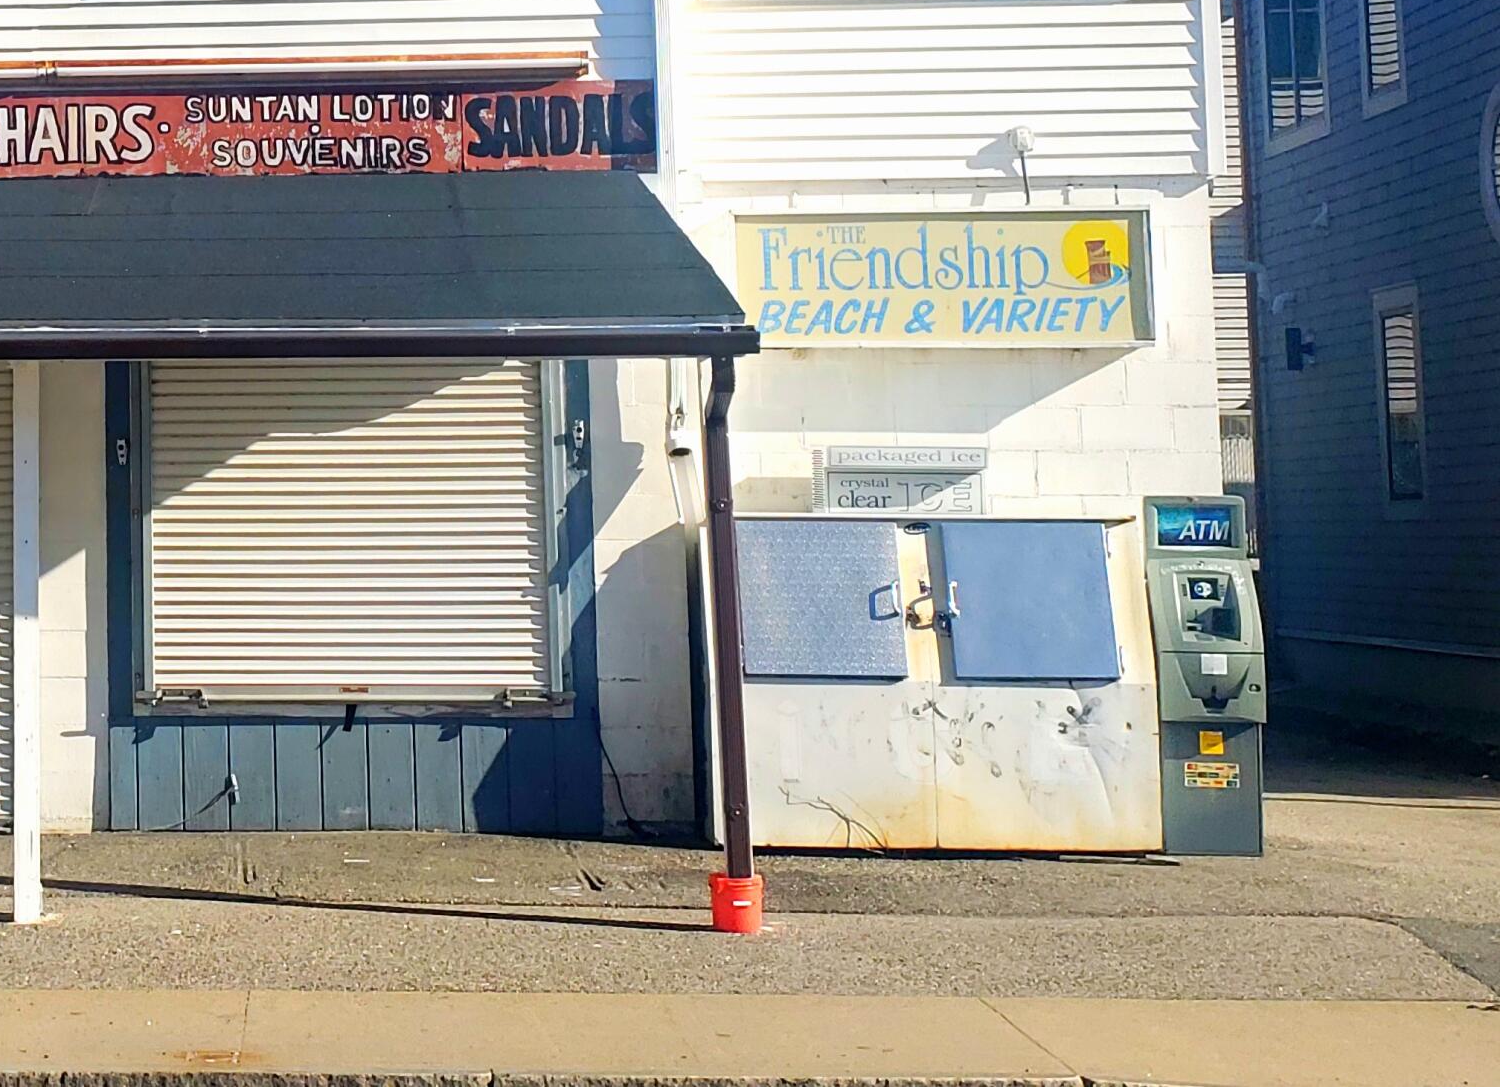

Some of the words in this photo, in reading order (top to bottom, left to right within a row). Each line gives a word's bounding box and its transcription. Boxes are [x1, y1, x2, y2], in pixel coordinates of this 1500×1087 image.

[184, 94, 321, 123] SUNTAN
[330, 94, 456, 122] LOTION
[465, 92, 658, 158] SANDALS
[211, 135, 432, 169] SOUVENIRS
[826, 225, 867, 245] THE
[756, 221, 1050, 296] Friendship
[758, 297, 889, 336] BEACH
[904, 299, 937, 334] &
[960, 295, 1126, 335] VARIETY
[837, 449, 941, 464] packaged
[951, 449, 981, 462] ice
[837, 490, 891, 509] clear
[840, 478, 889, 493] crystal
[897, 478, 973, 512] ICE
[1178, 519, 1230, 541] ATM
